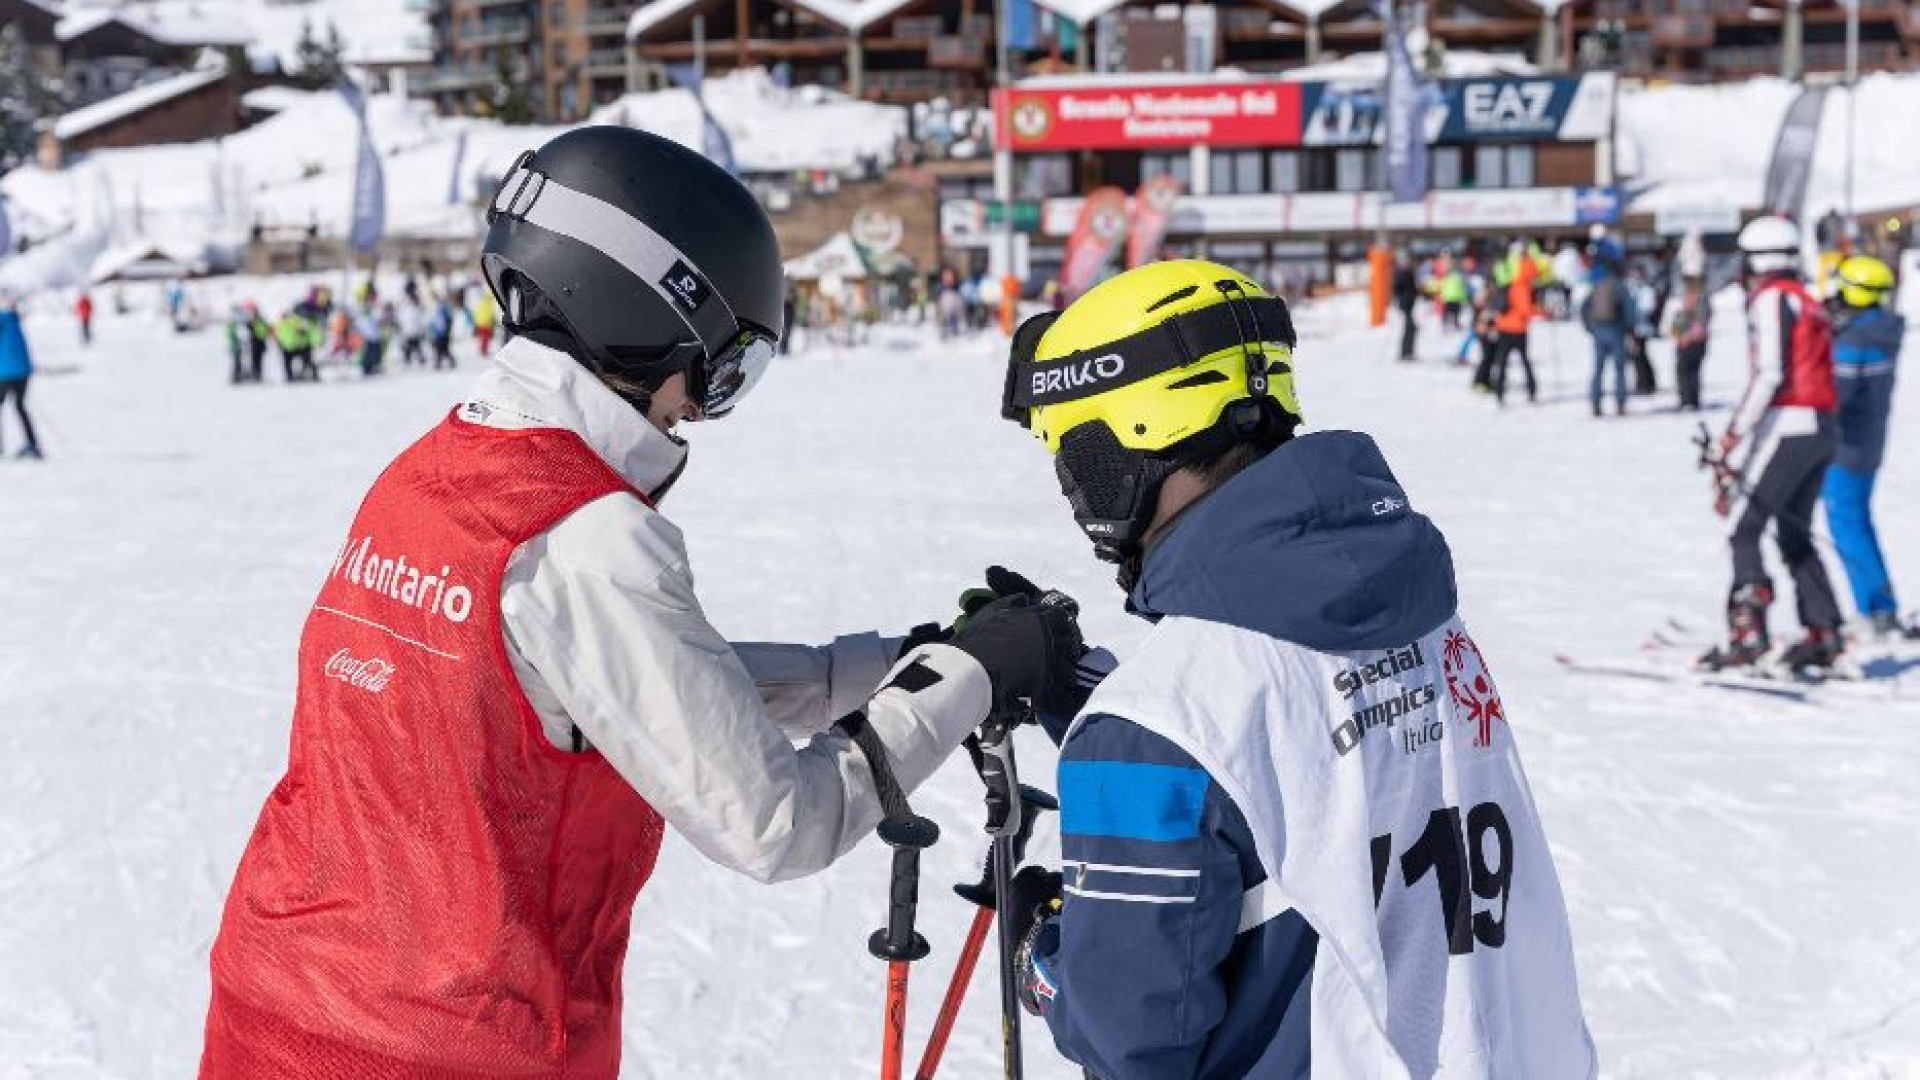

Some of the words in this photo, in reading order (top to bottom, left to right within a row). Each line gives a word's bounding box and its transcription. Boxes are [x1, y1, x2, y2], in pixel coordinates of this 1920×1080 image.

[1464, 81, 1555, 120] EA7
[1032, 353, 1124, 394] BRIKO
[332, 536, 472, 622] Vlontario
